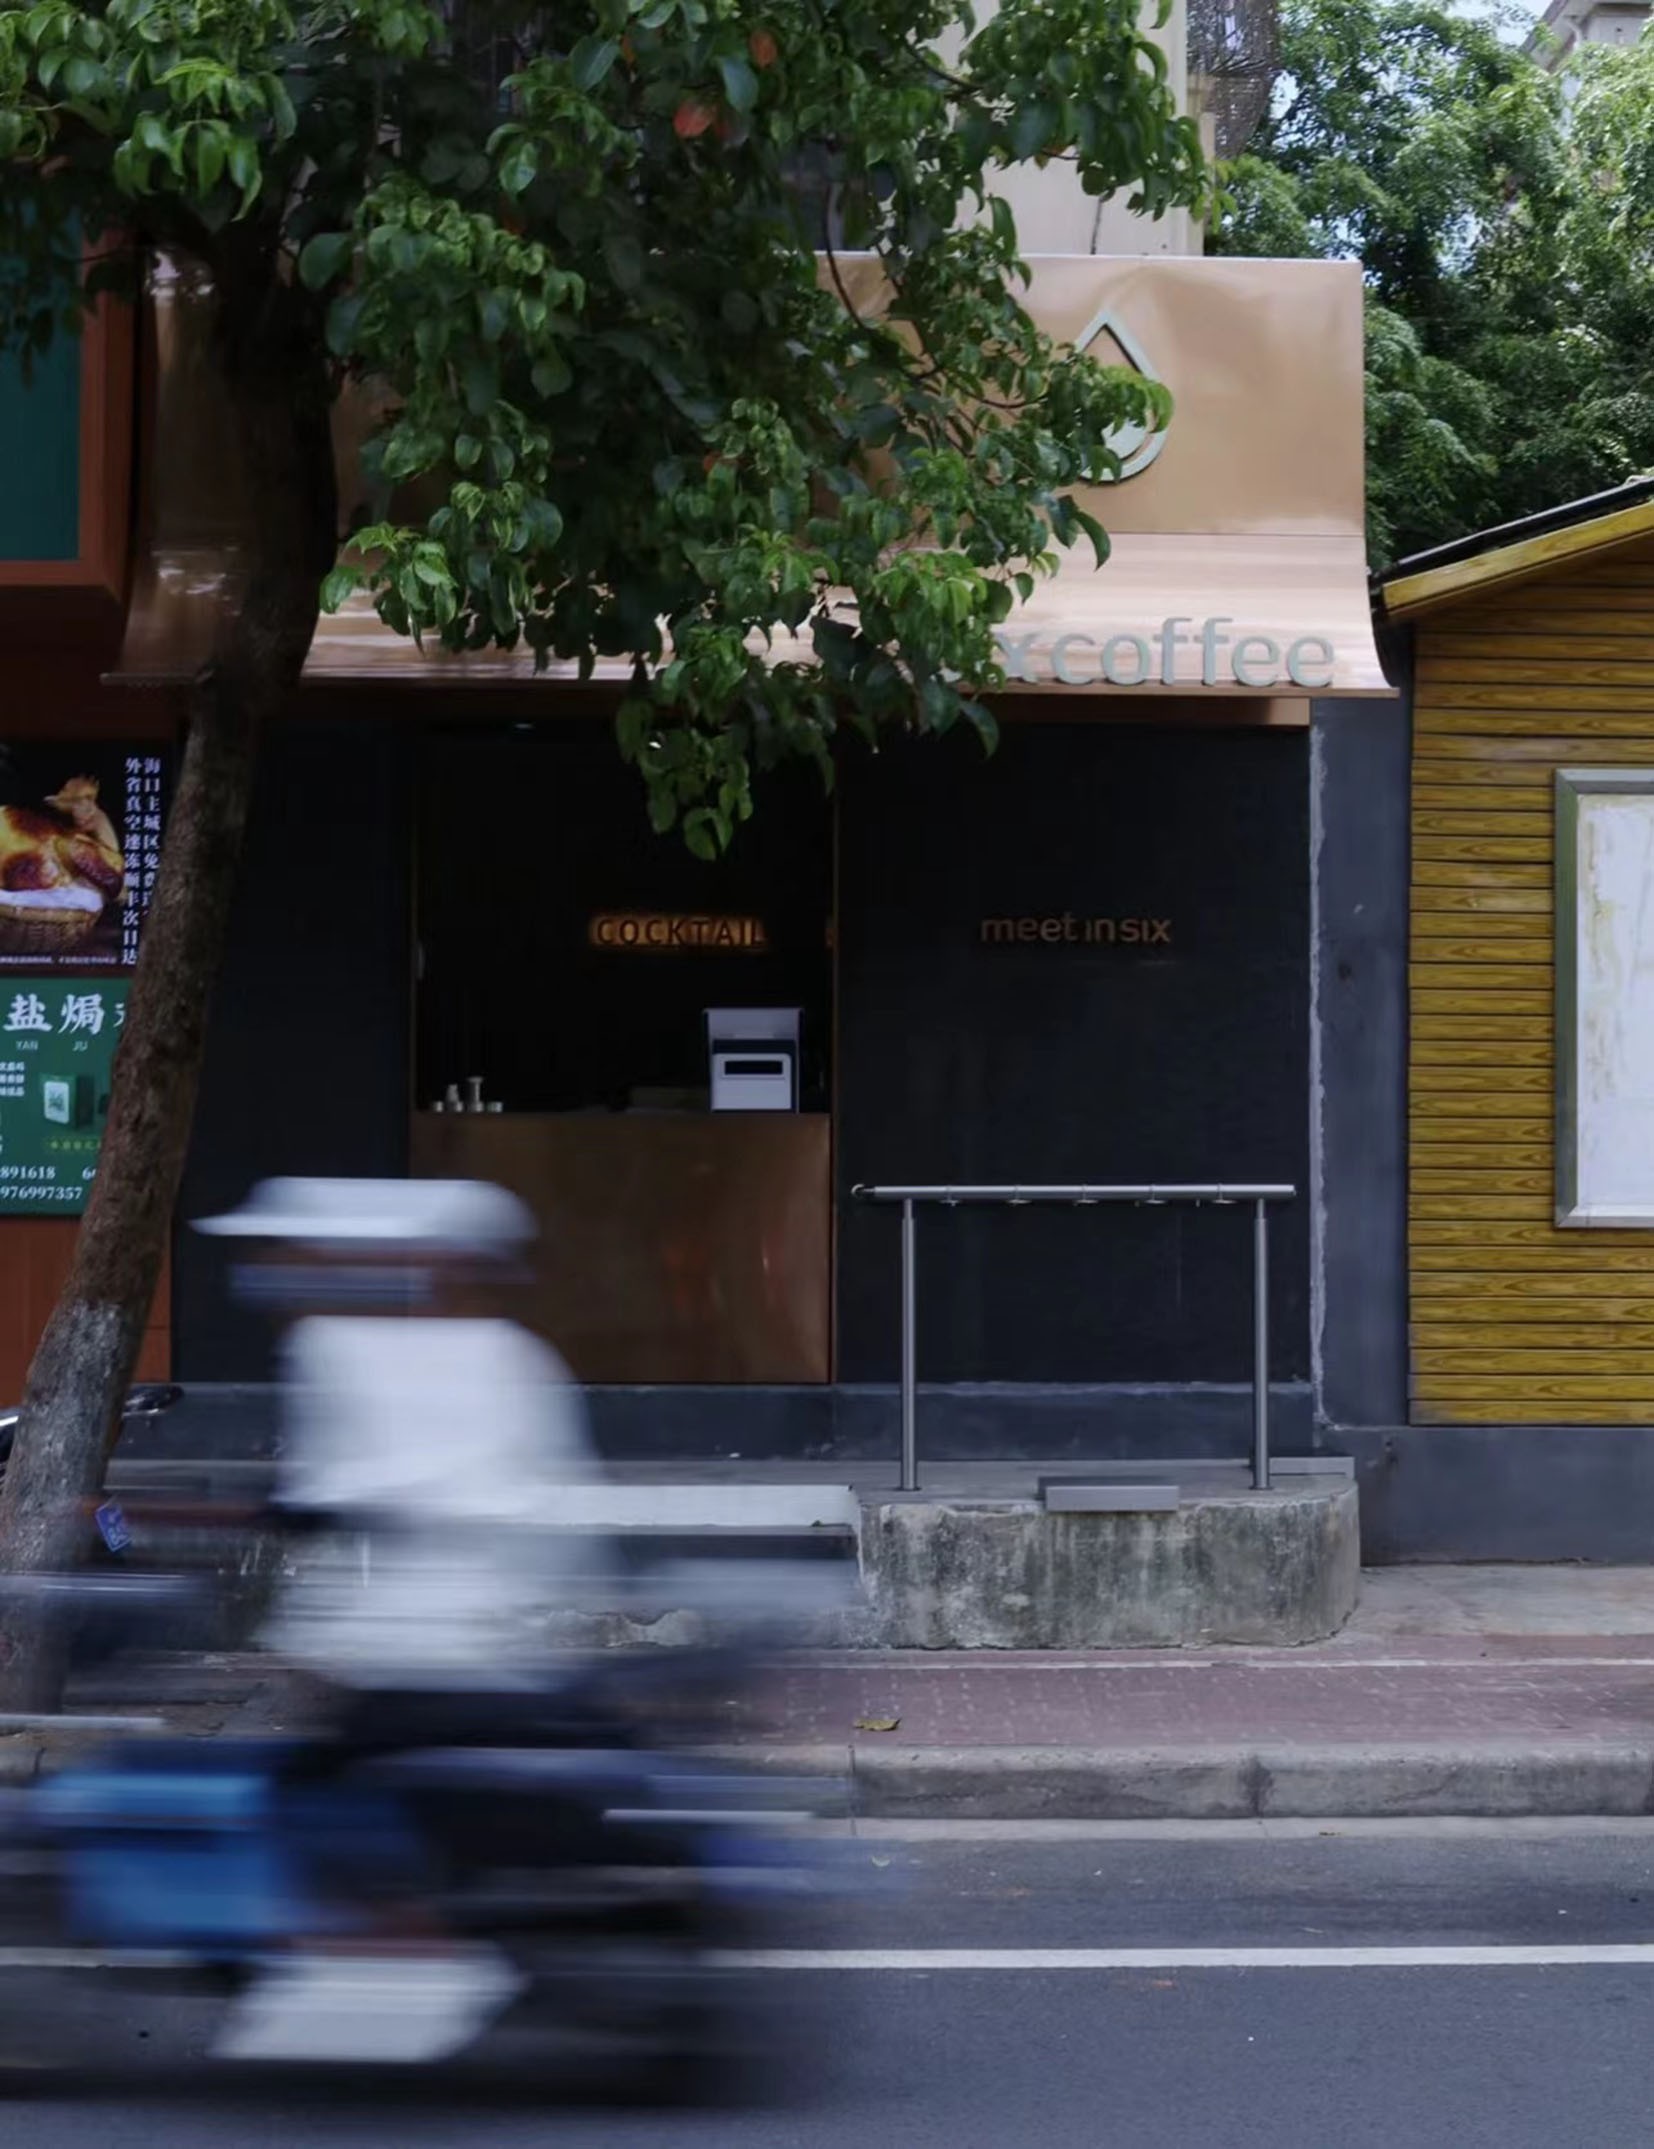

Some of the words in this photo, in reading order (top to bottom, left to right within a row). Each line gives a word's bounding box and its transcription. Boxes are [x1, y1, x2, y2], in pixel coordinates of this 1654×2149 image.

[597, 918, 765, 946] COCKTAIL
[981, 911, 1077, 942] meet
[16, 1040, 39, 1051] YAN
